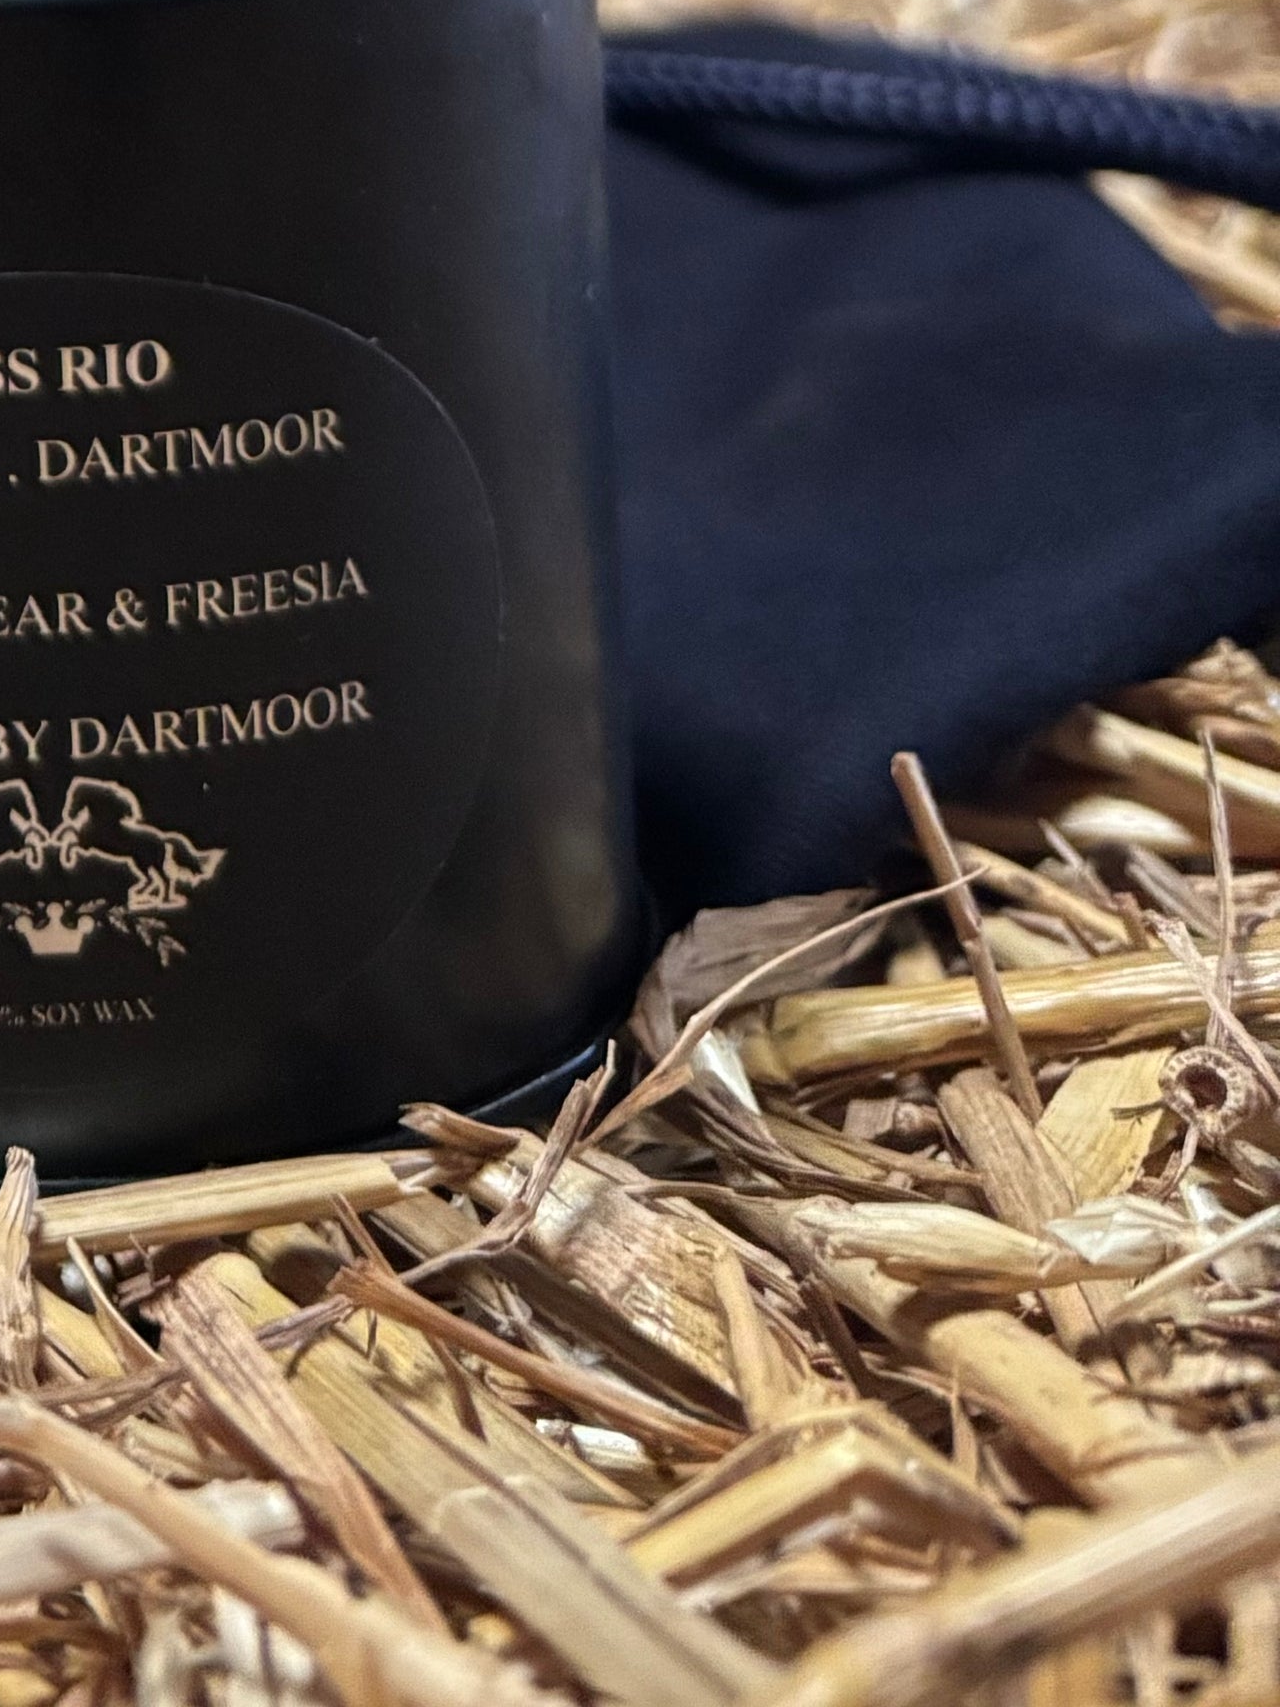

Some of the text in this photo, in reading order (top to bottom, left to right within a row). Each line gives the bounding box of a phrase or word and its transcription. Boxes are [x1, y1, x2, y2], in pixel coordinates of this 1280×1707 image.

[57, 339, 172, 391] RIO
[38, 407, 343, 484] DARTMOOR
[107, 588, 147, 632] &
[165, 557, 370, 628] FREESIA
[69, 680, 373, 760] DARTMOOR
[32, 1003, 85, 1027] SOY
[95, 998, 157, 1023] WAX
